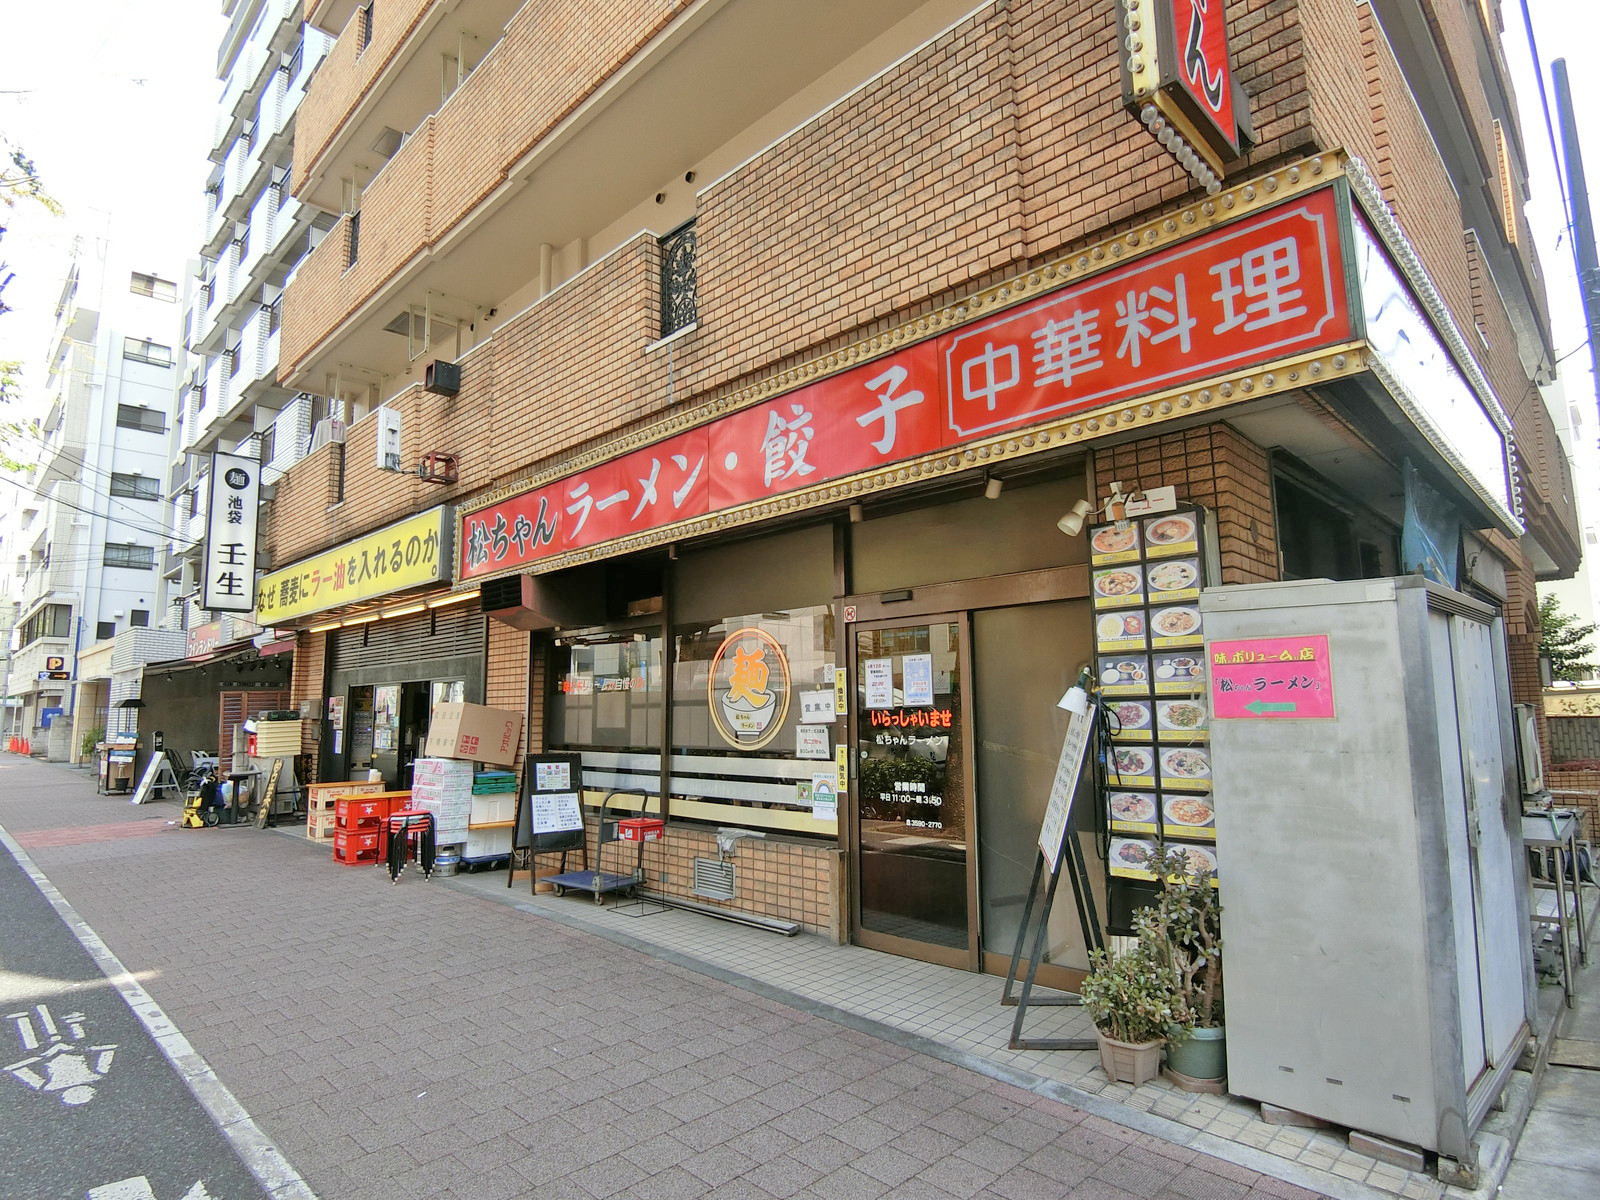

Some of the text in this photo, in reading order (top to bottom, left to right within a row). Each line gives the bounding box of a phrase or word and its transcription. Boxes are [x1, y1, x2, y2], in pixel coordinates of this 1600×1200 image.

[1184, 0, 1223, 112] ん
[961, 236, 1307, 412] 中華料理
[215, 494, 247, 596] 池袋 壬生
[49, 658, 62, 670] P
[871, 709, 952, 728] いらっしゃいませ
[875, 734, 944, 746] 松ちゃんラーメン
[893, 781, 926, 793] 営業時間
